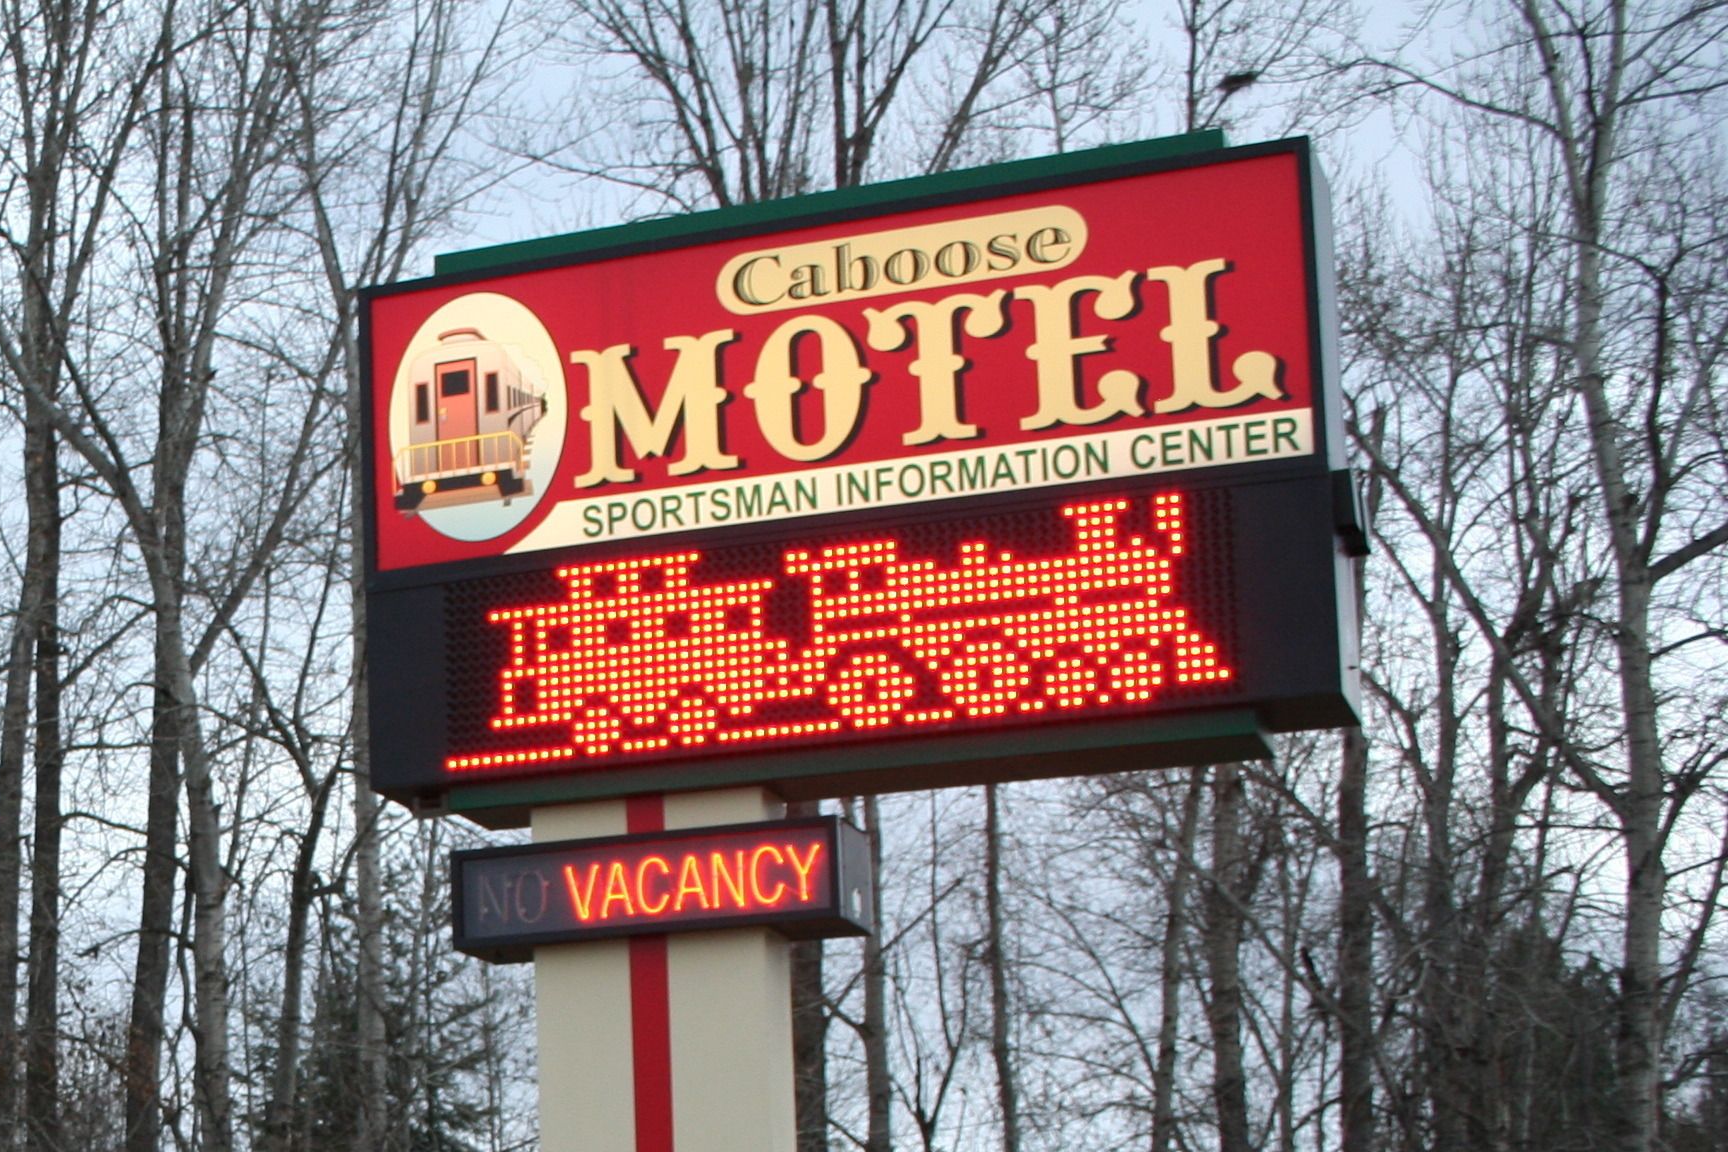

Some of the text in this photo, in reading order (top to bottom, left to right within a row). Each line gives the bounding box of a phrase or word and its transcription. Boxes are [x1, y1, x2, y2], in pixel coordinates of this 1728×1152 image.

[731, 219, 1073, 308] Caboose
[570, 257, 1284, 490] MOTEL
[581, 414, 1301, 541] SPORTSMAN INFORMATION CENTER
[478, 841, 822, 924] NO VACANCY
